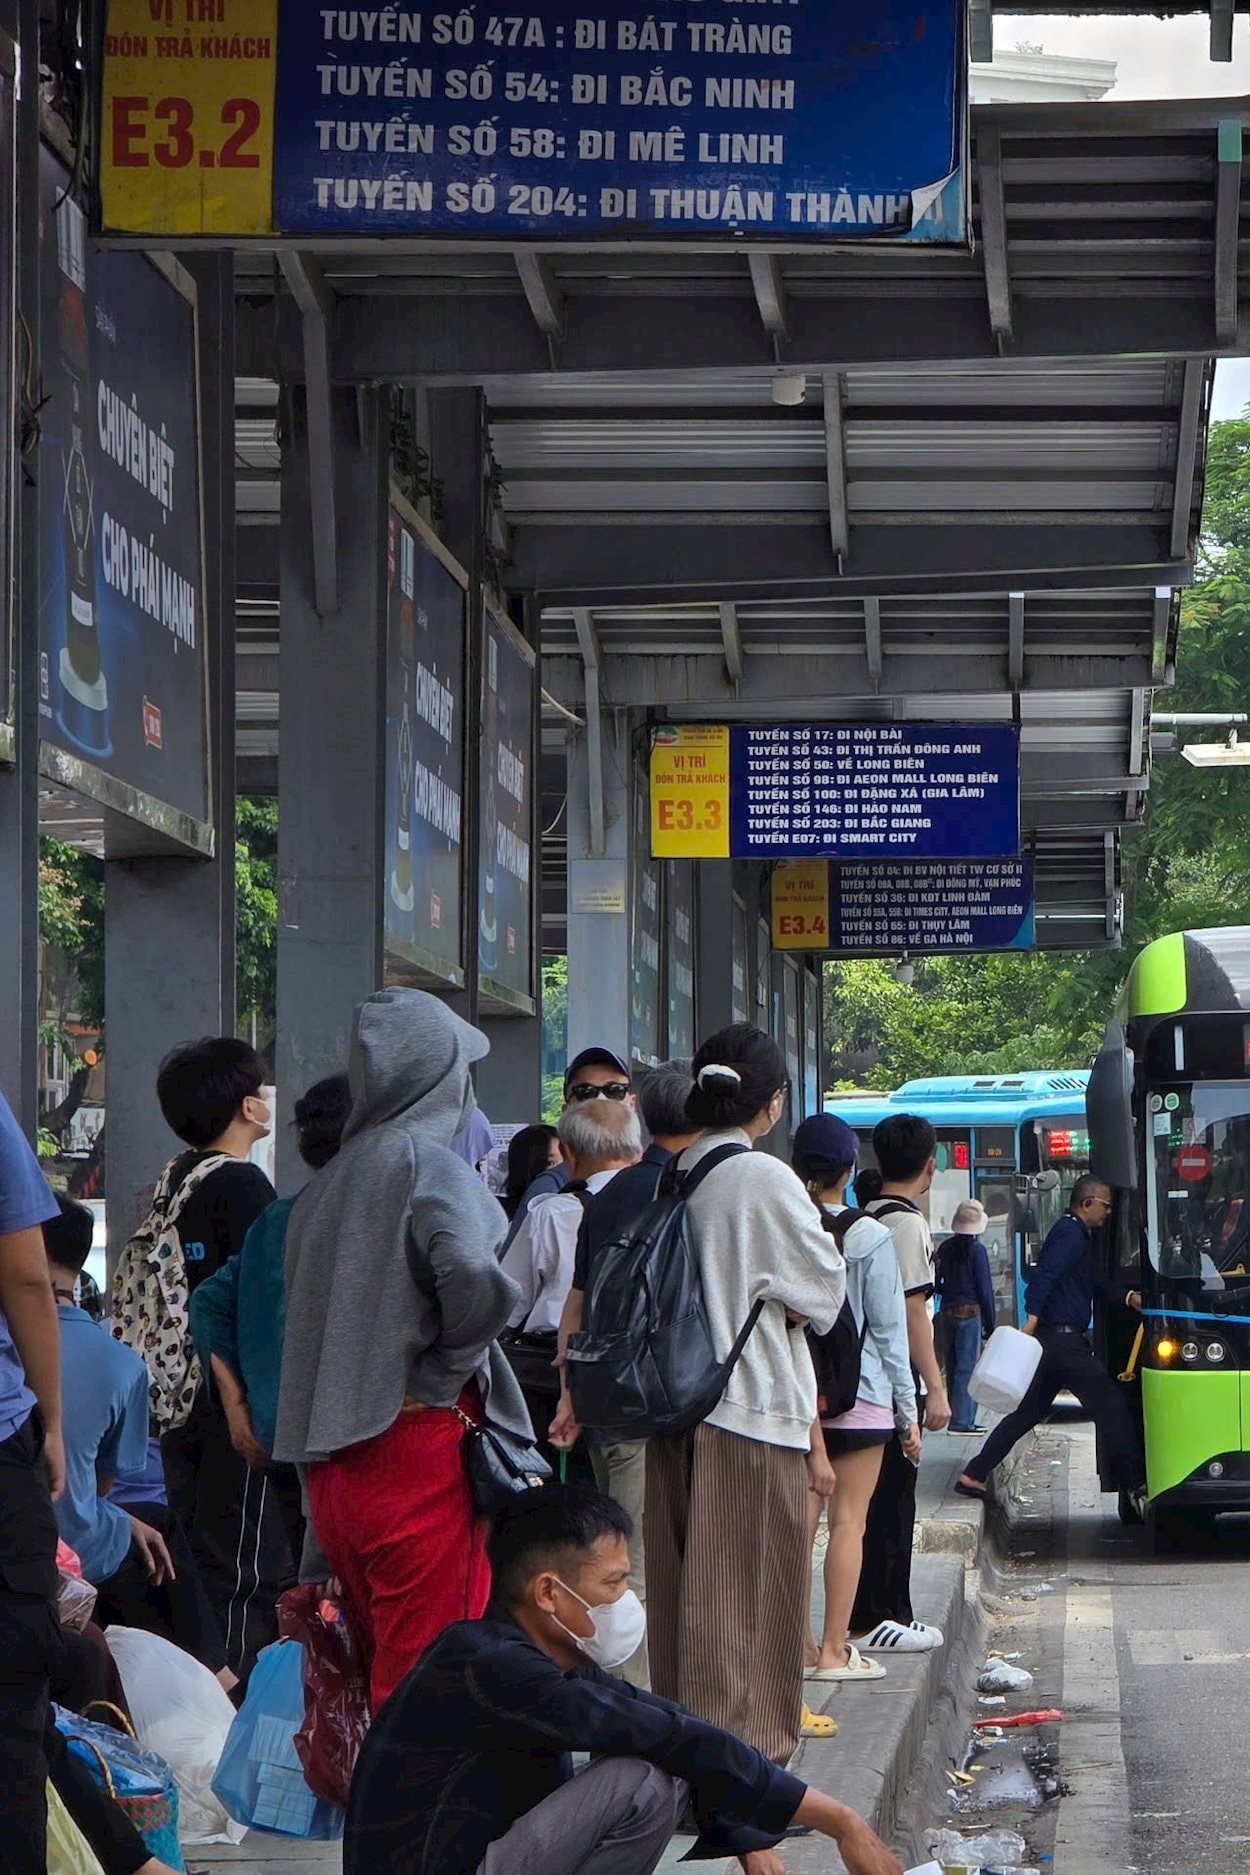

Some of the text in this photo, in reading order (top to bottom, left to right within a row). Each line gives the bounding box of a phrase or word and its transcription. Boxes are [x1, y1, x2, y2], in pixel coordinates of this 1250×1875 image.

[319, 2, 793, 55] TUYẾN SỐ 47A ĐI BÁT TRÀNG
[105, 28, 271, 59] ĐÓN TRẢ KHÁCH
[316, 57, 796, 110] TUYẾN SỐ 54: ĐI BẮC NINH
[112, 96, 261, 168] E3.2
[315, 112, 784, 165] TUYẾN SỐ 58: ĐI MÊ LINH
[313, 170, 910, 227] TUYẾN SỐ 204: ĐI THUẬN THÀNH
[97, 379, 147, 489] CHUYÊN
[148, 422, 176, 525] BIỆT
[101, 511, 196, 654] CHO PHÁI MẠNH
[748, 727, 902, 743] TUYẾN SỐ 17: ĐI NỘI BÀI
[747, 741, 981, 757] TUYẾN SỐ 43: ĐI THỊ TRẤN ĐÔNG ANH
[673, 754, 706, 772] VỊ TRÍ
[748, 757, 789, 771] TUYẾN
[792, 757, 812, 771] SỐ
[813, 760, 834, 770] 50:
[857, 759, 891, 769] LONG
[893, 757, 925, 769] BIÊN
[748, 771, 998, 786] TUYẾN SỐ 98: ĐI AEON MALL LONG BIÊN
[747, 787, 789, 800] TUYẾN
[792, 787, 811, 800] SỐ
[813, 790, 841, 800] 100:
[844, 789, 858, 799] ĐI
[861, 786, 897, 800] ĐẶNG
[922, 788, 949, 799] (GIA
[951, 786, 985, 798] LÂM)
[658, 799, 722, 832] E3.3
[748, 801, 789, 815] TUYẾN
[792, 801, 812, 815] SỐ
[813, 805, 842, 814] 146:
[844, 804, 859, 814] ĐI
[891, 804, 922, 814] NAM
[748, 815, 932, 829] TUYẾN SỐ 203: ĐI BẮC GIANG
[747, 830, 918, 844] TUYẾN E07: ĐI SMART CITY
[780, 915, 826, 935] E3.4
[923, 935, 937, 944] GA
[940, 932, 953, 944] HÀ
